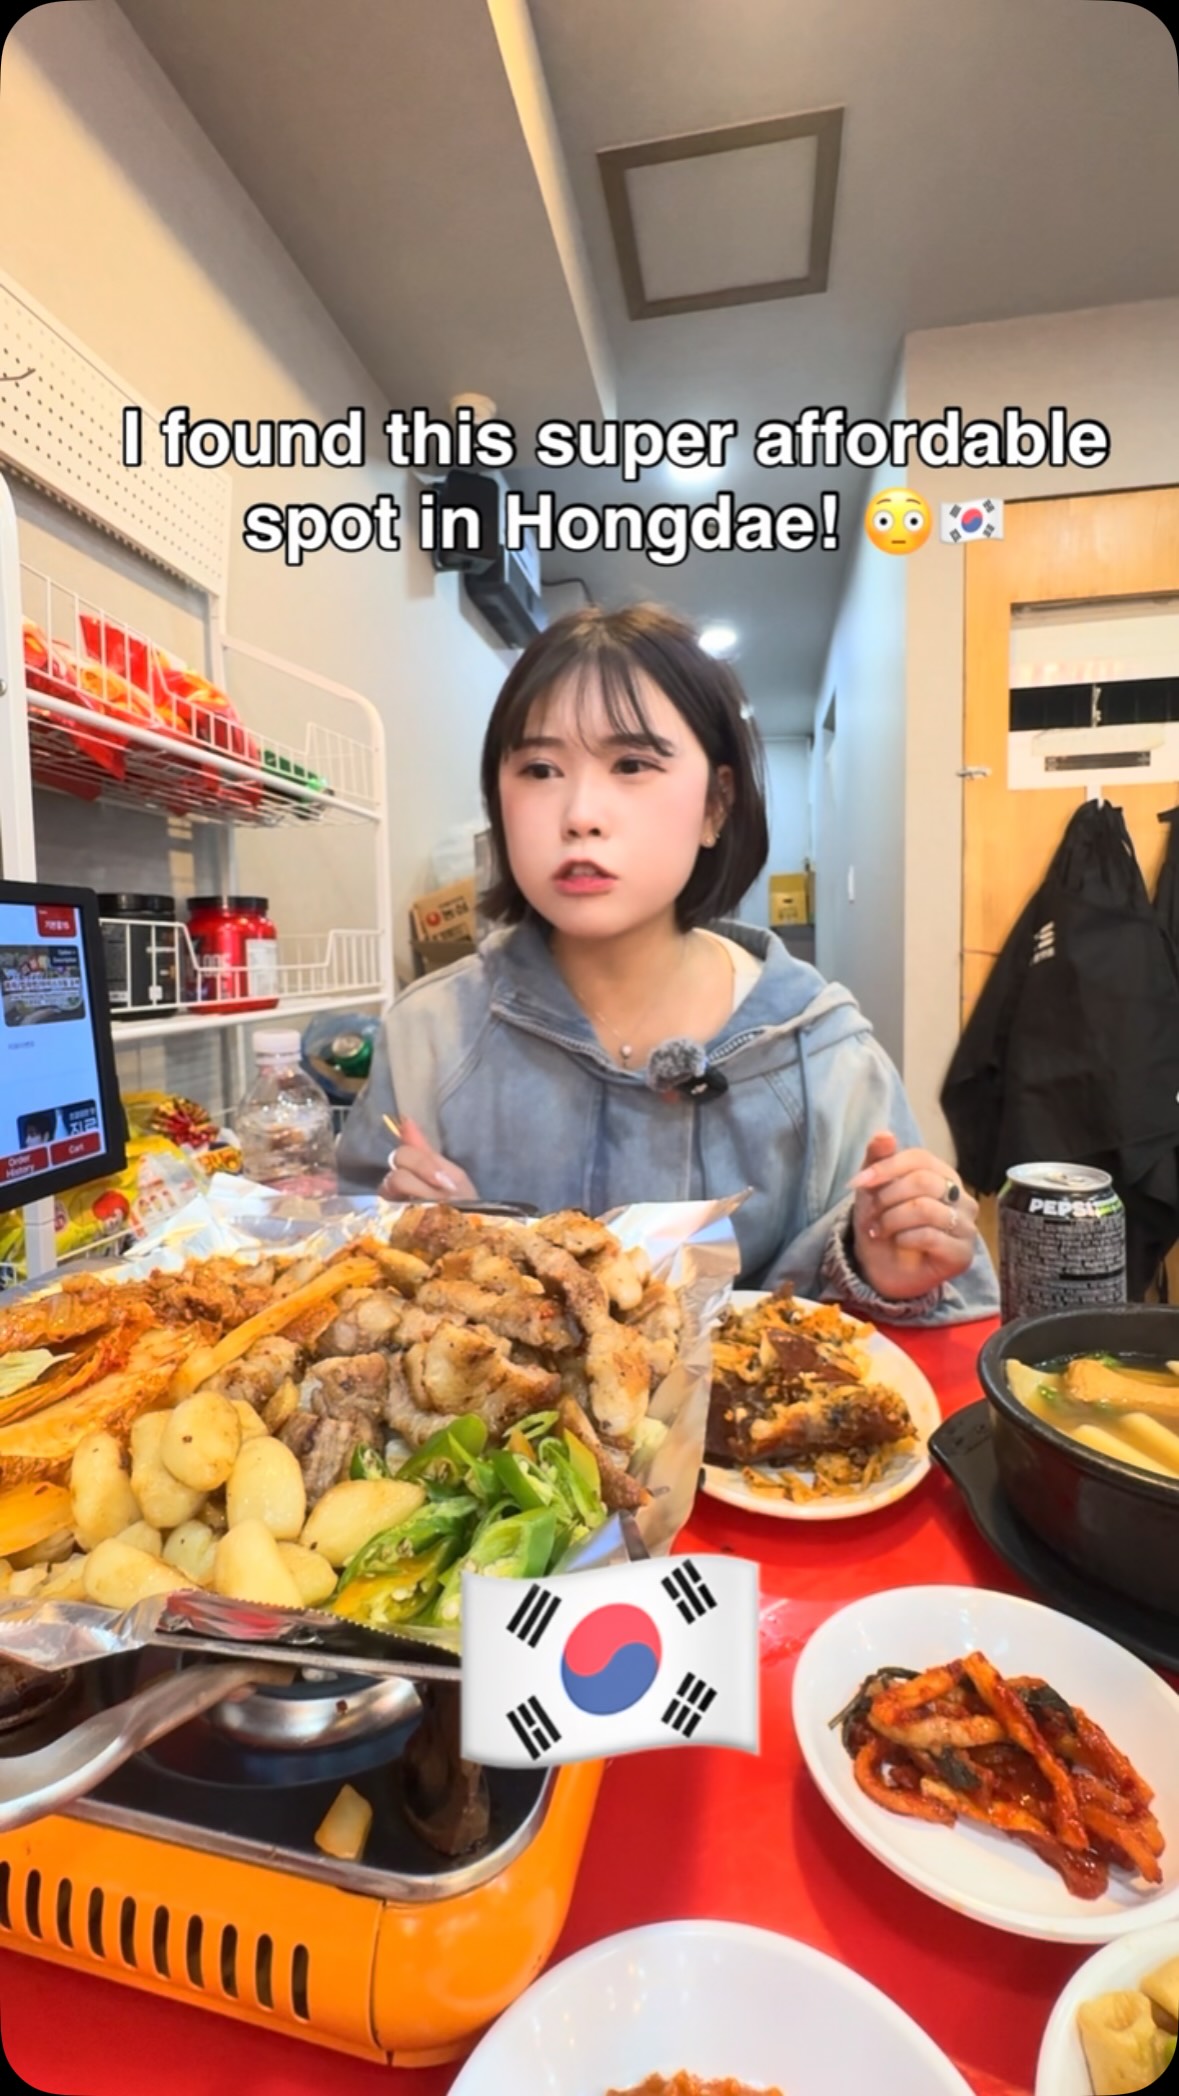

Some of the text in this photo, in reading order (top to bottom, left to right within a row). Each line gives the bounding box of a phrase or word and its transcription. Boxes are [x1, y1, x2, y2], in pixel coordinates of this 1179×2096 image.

[68, 1142, 85, 1155] Cart
[7, 1153, 31, 1167] Order
[6, 1164, 35, 1179] History
[1028, 1197, 1098, 1219] PEPSI
